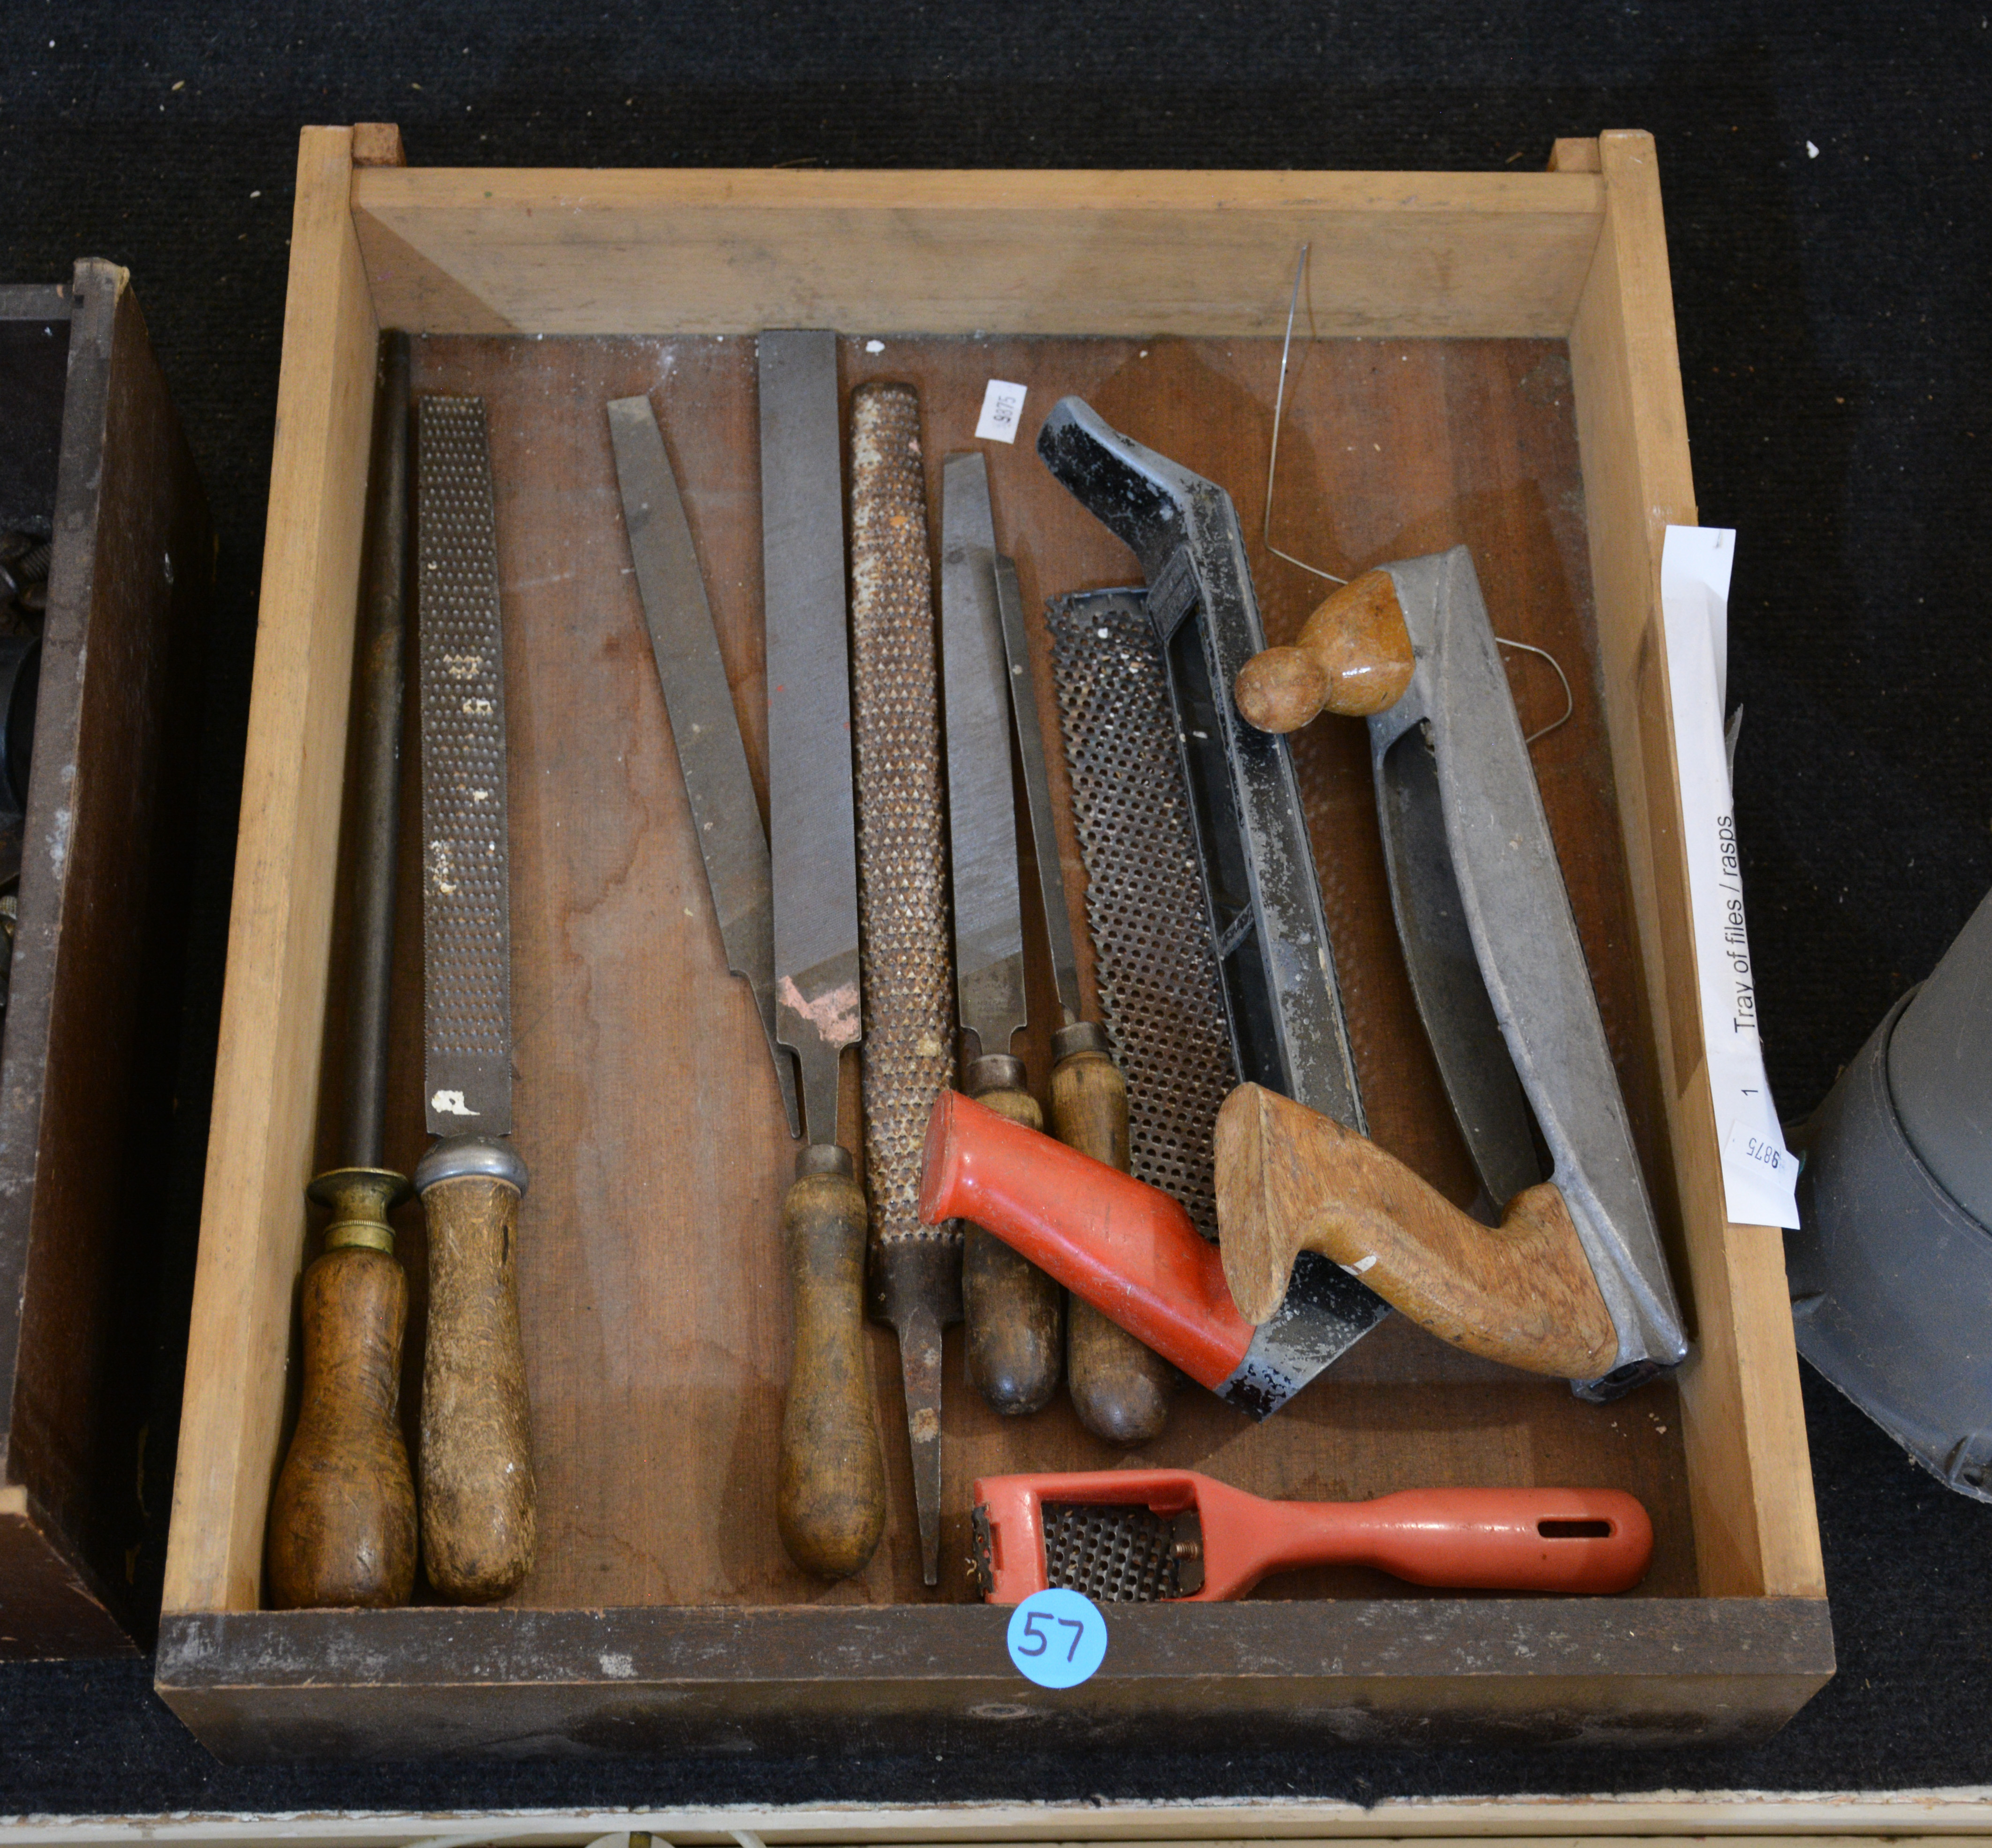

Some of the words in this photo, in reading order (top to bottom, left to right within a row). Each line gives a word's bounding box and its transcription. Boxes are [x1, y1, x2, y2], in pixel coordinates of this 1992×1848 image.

[1717, 815, 1738, 876] rasps
[1719, 883, 1740, 893] /
[1724, 899, 1745, 944] files
[1727, 950, 1749, 973] of
[1734, 981, 1755, 1033] Tray
[1746, 1138, 1780, 1169] 9875
[1017, 1611, 1084, 1663] 57
